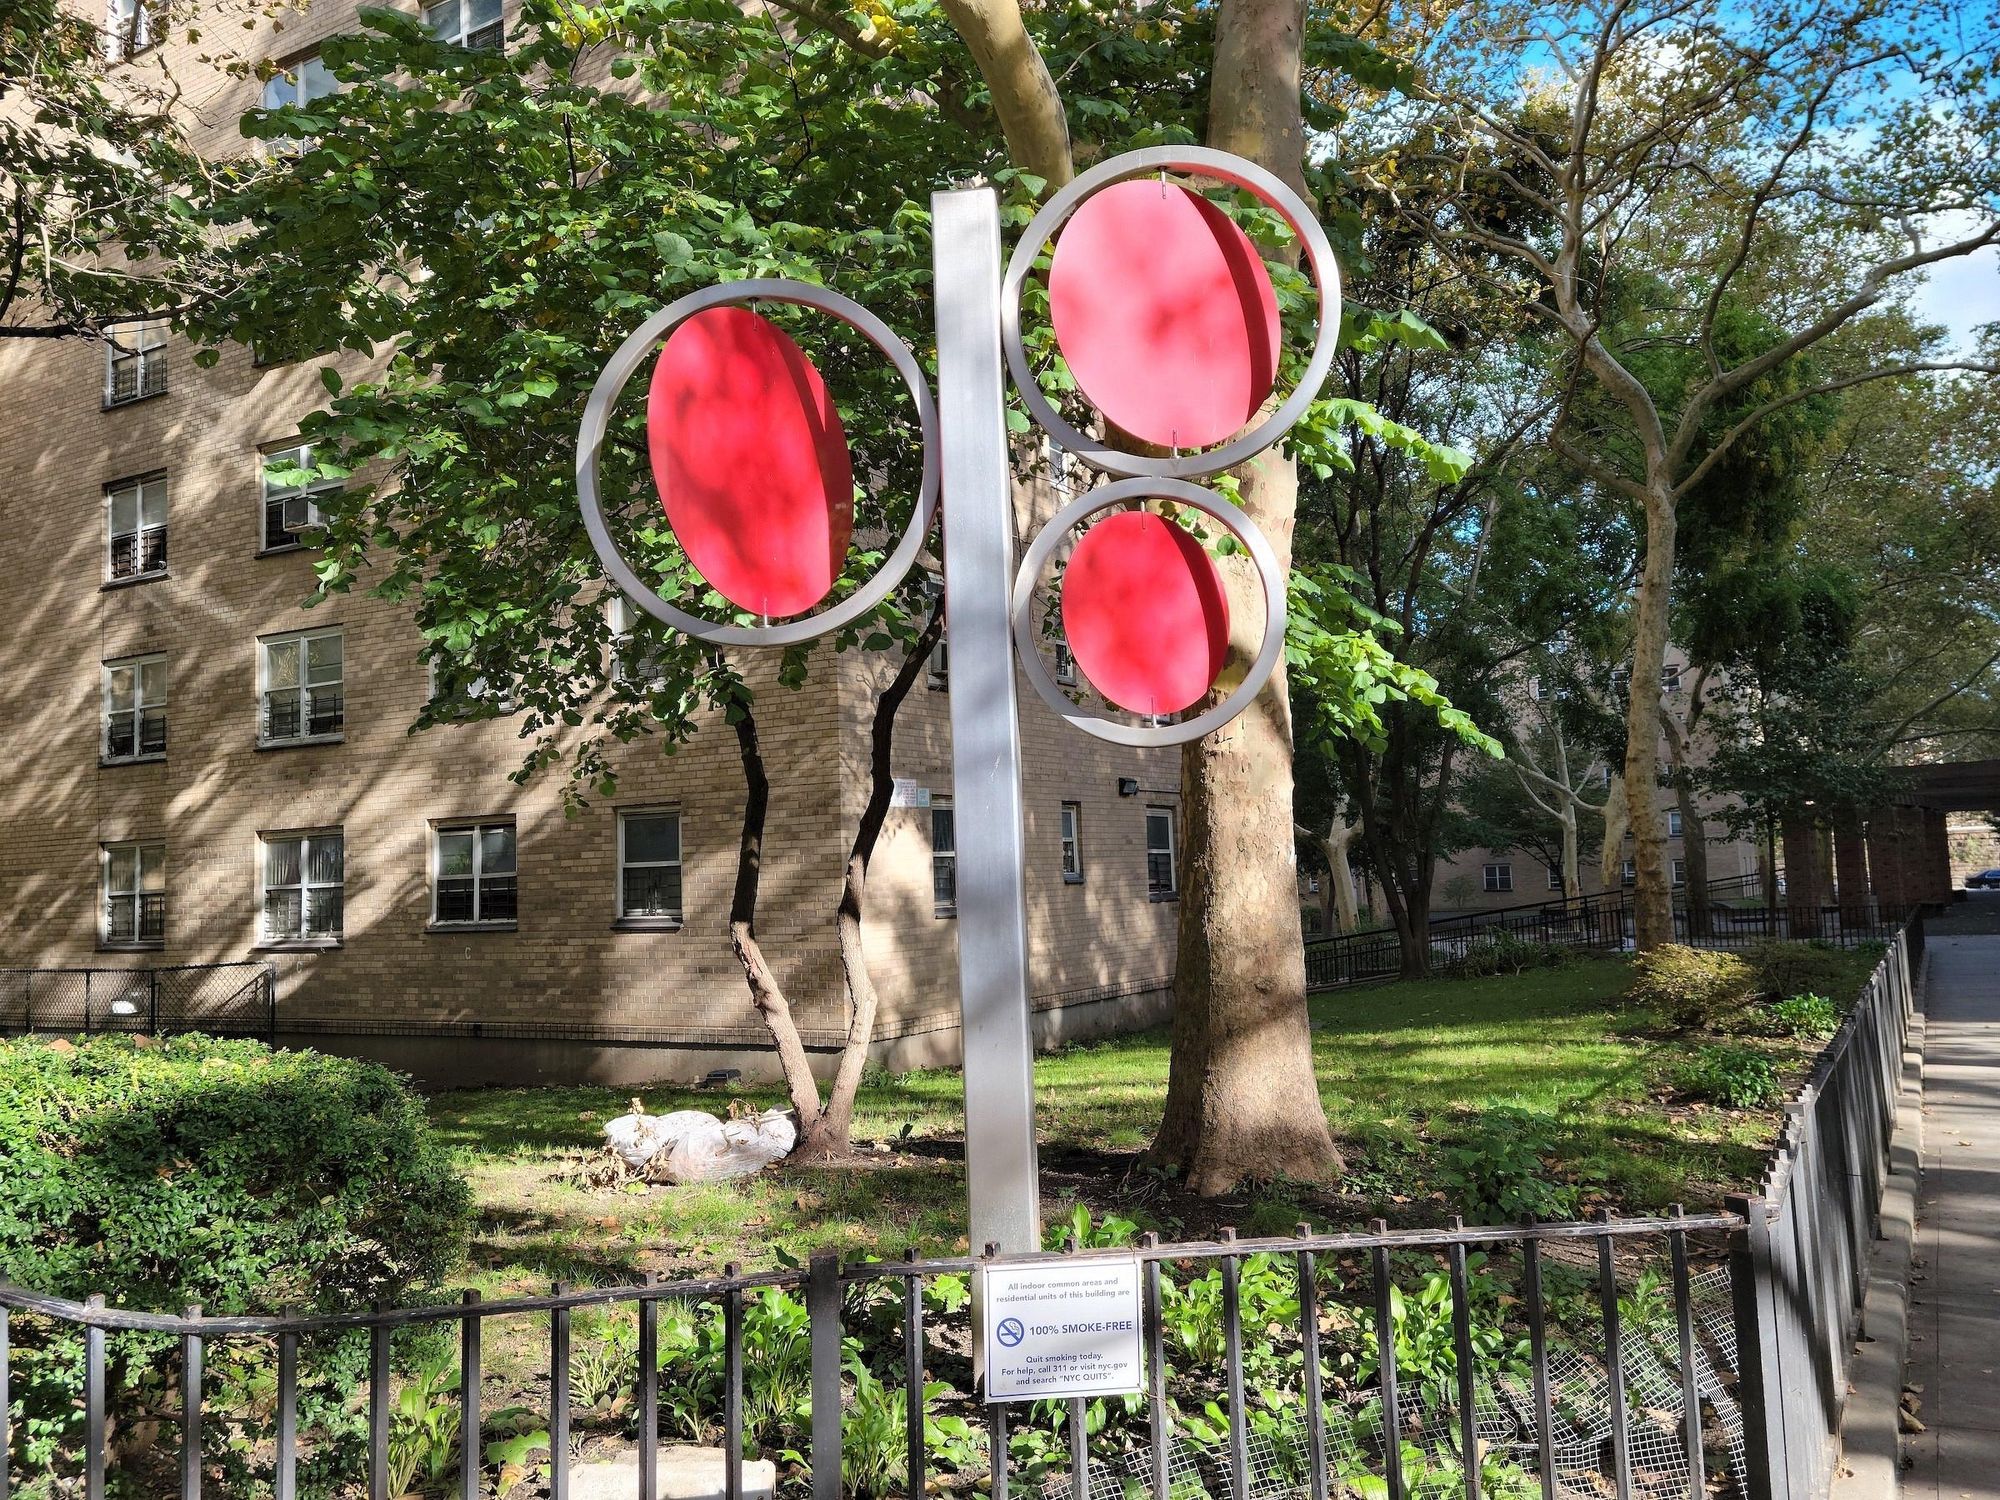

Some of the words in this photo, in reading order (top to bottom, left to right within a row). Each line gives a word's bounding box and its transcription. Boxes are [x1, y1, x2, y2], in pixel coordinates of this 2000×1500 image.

[1020, 1281, 1045, 1289] indoor
[1086, 1290, 1115, 1298] building
[1030, 1324, 1058, 1336] 100%
[1062, 1321, 1132, 1333] SMOKE-FREE
[1045, 1354, 1077, 1363] smoking
[1080, 1353, 1103, 1361] today.
[1017, 1367, 1035, 1376] help,
[1060, 1374, 1080, 1382] "NYC
